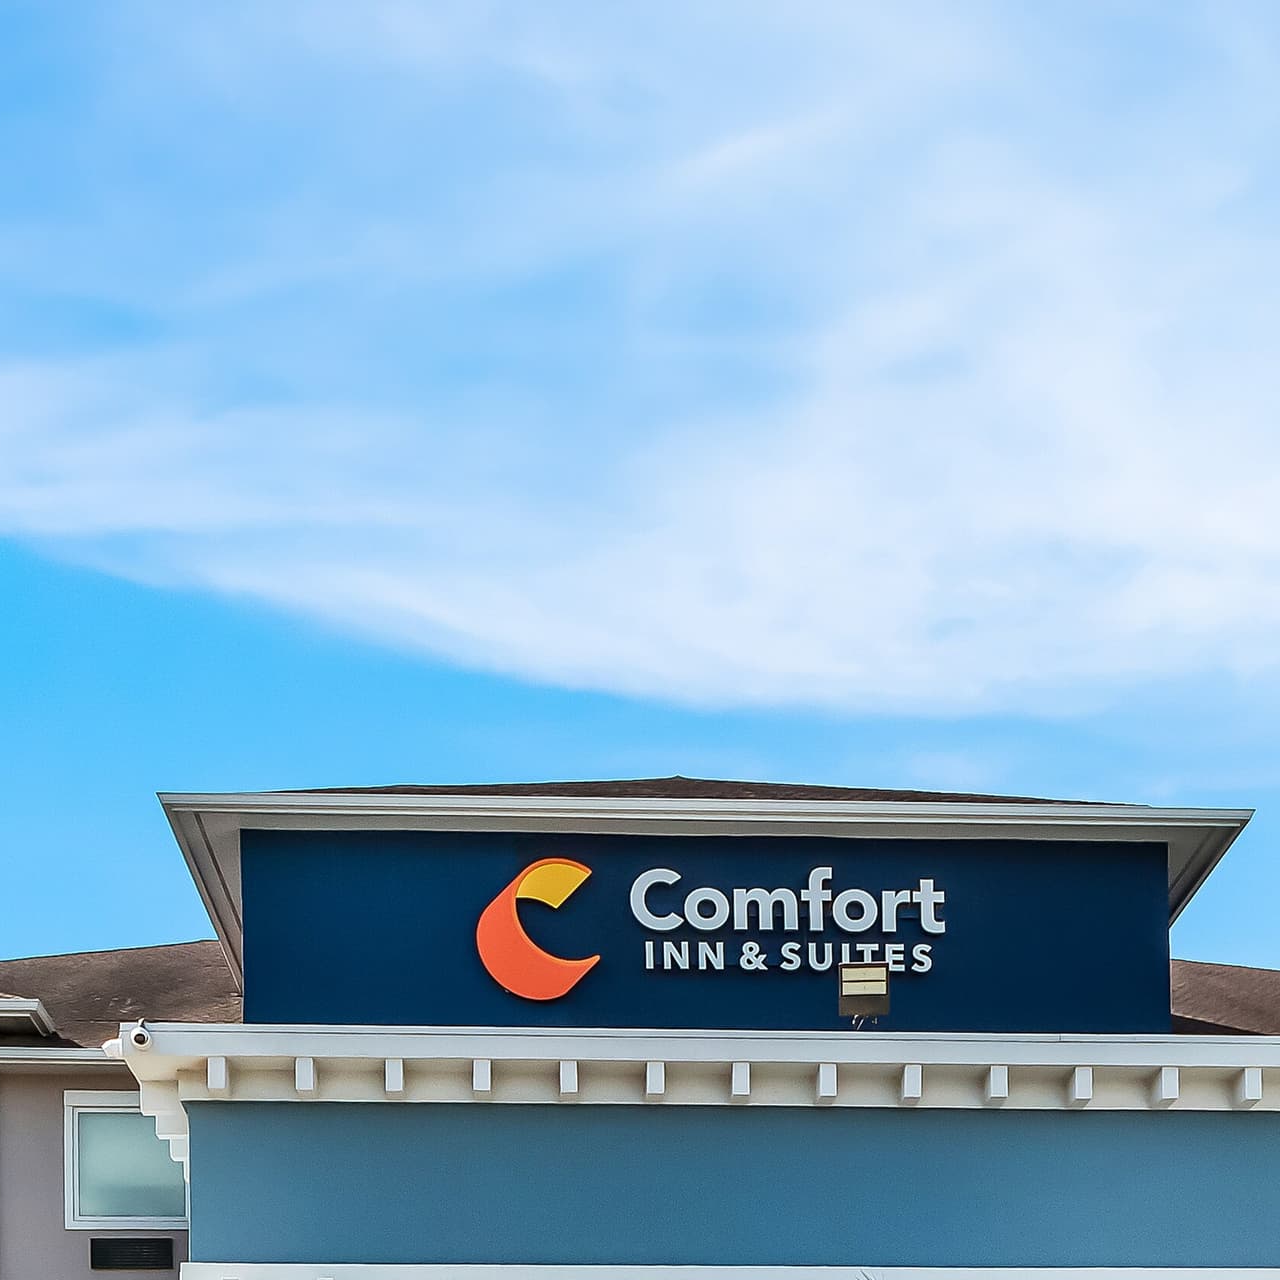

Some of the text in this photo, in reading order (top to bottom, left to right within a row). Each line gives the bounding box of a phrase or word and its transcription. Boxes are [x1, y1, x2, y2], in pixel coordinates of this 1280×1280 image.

[630, 867, 946, 933] Comfort
[645, 941, 933, 972] INN & SUITES
